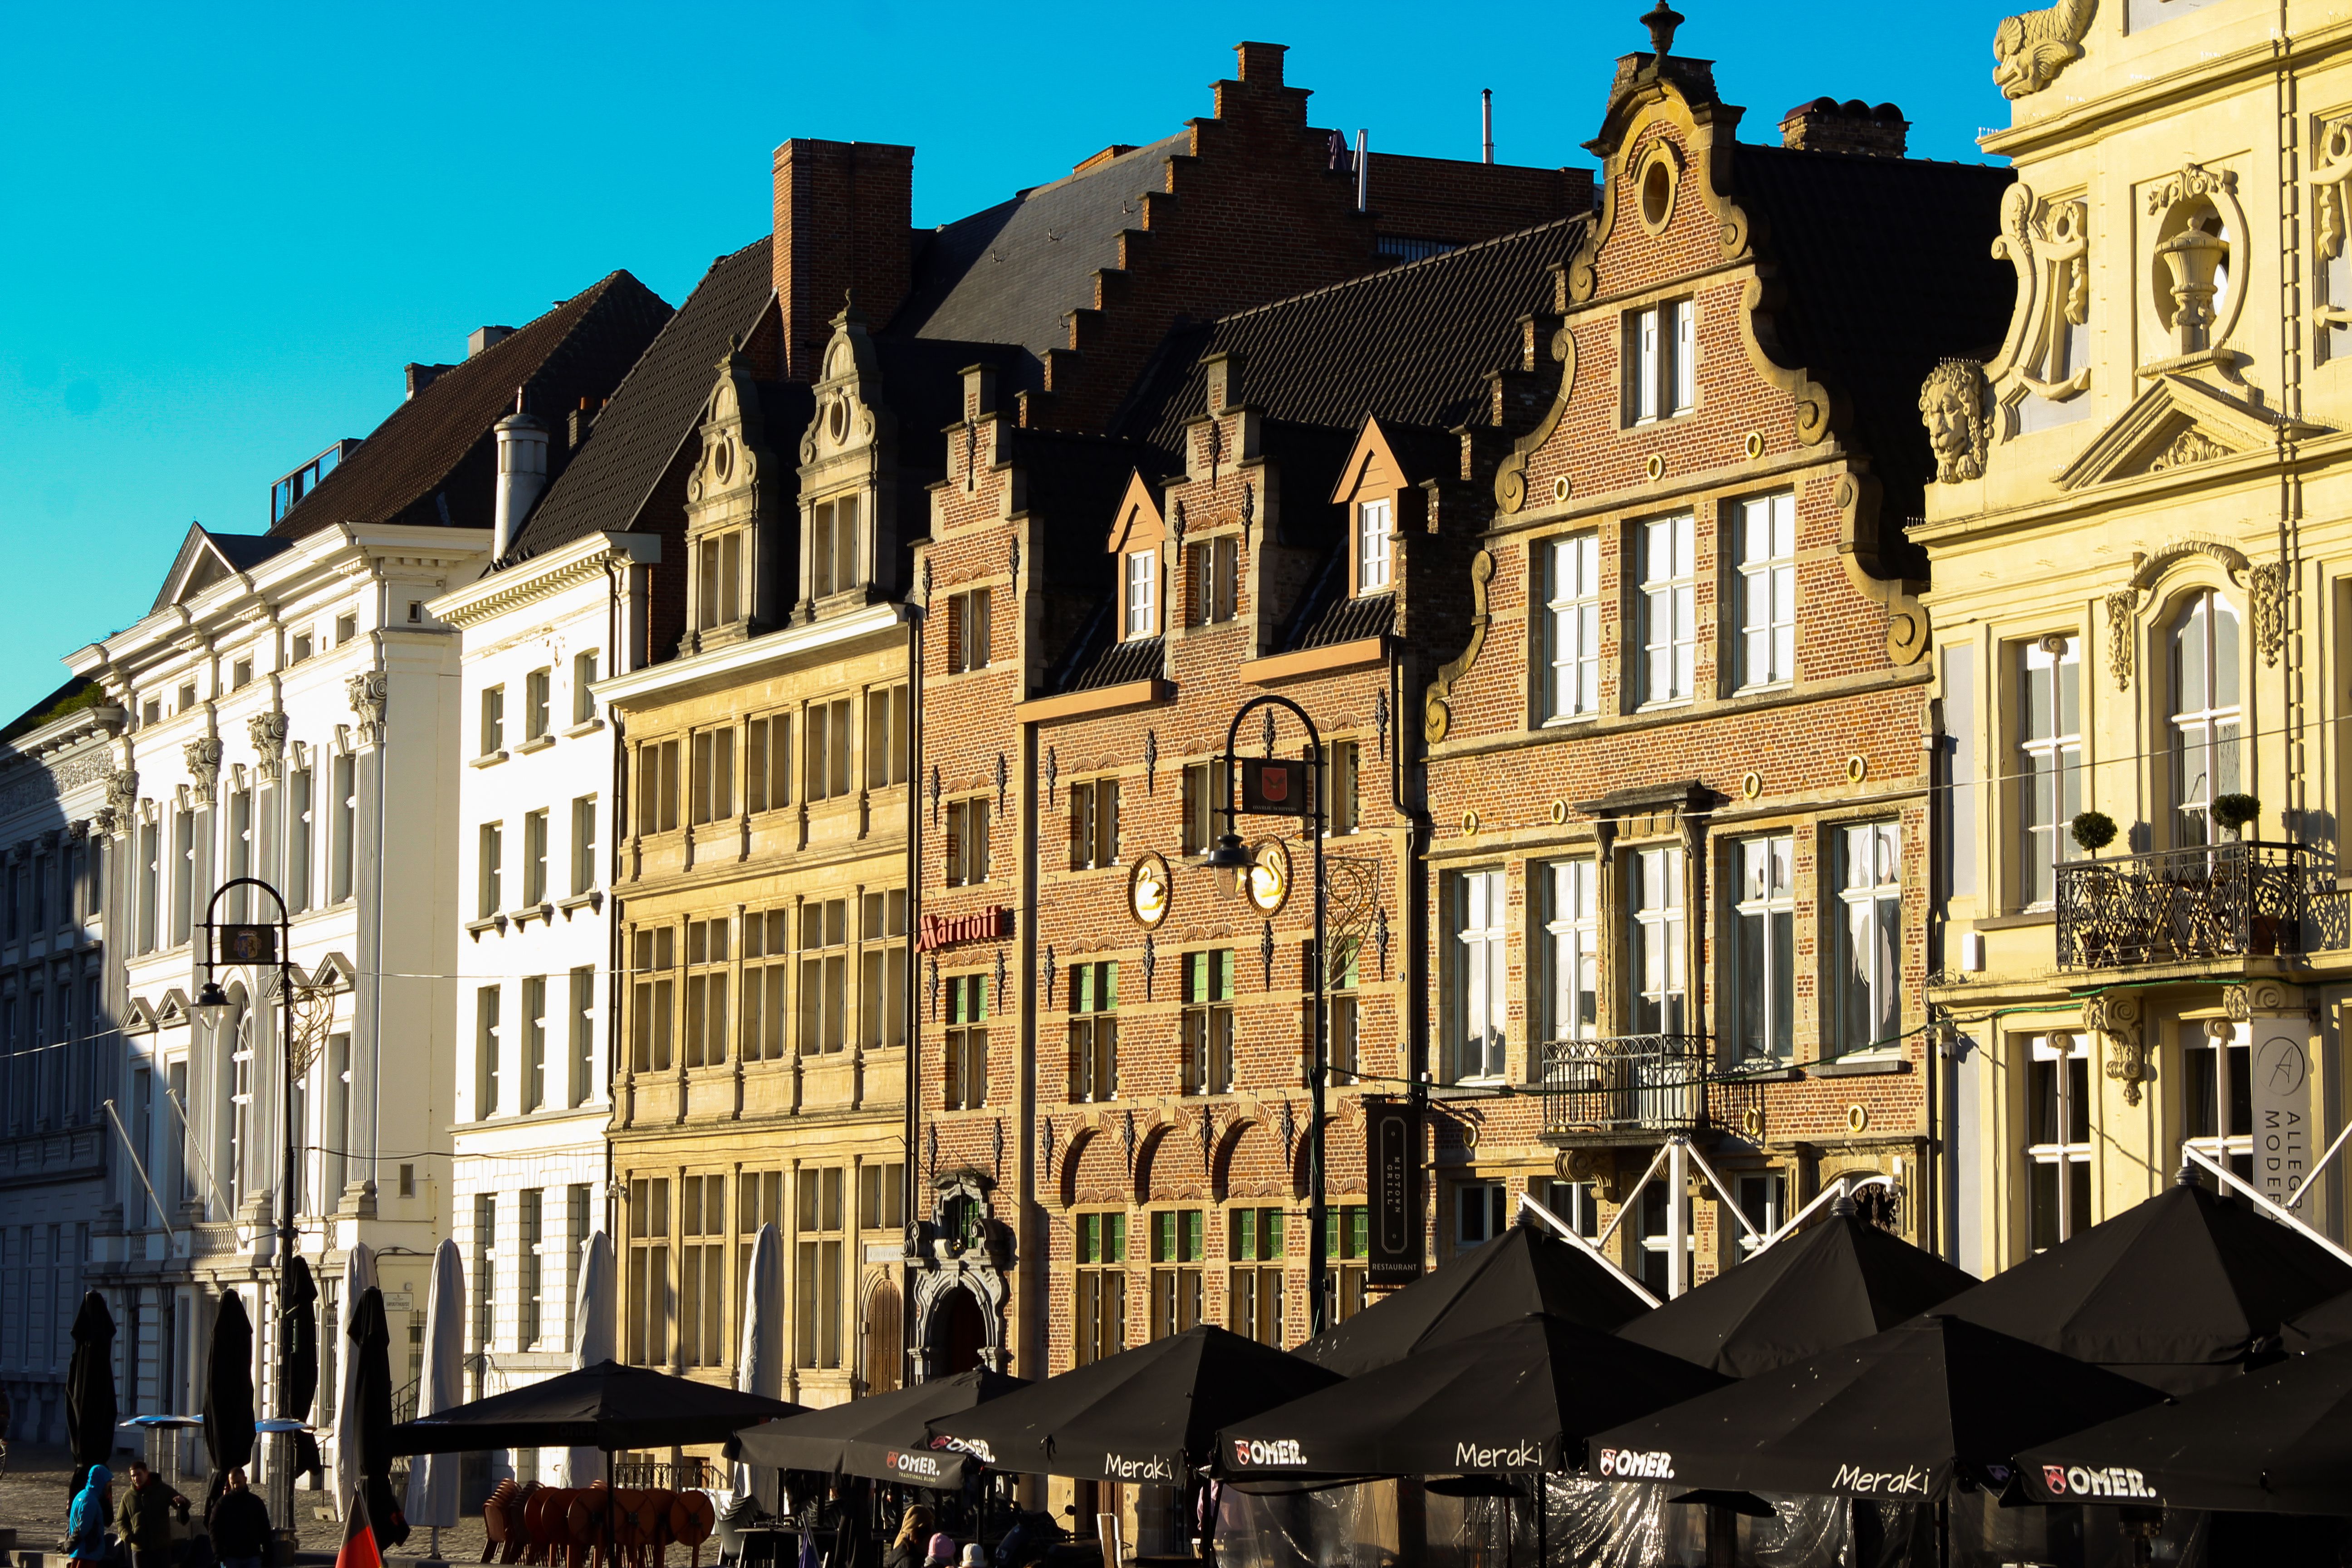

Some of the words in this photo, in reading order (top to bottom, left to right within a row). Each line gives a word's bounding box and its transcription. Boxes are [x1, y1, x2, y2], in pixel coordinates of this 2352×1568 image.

[916, 905, 996, 952] Marriott
[898, 1454, 940, 1476] OMER.
[1105, 1452, 1172, 1480] Meraki
[1250, 1440, 1308, 1465] OMER.
[1455, 1439, 1542, 1467] Meraki
[1616, 1449, 1675, 1479] OMER.
[899, 1472, 922, 1480] TRADITIONAL
[1832, 1464, 1931, 1494] Meraki
[2067, 1465, 2156, 1498] OMER.
